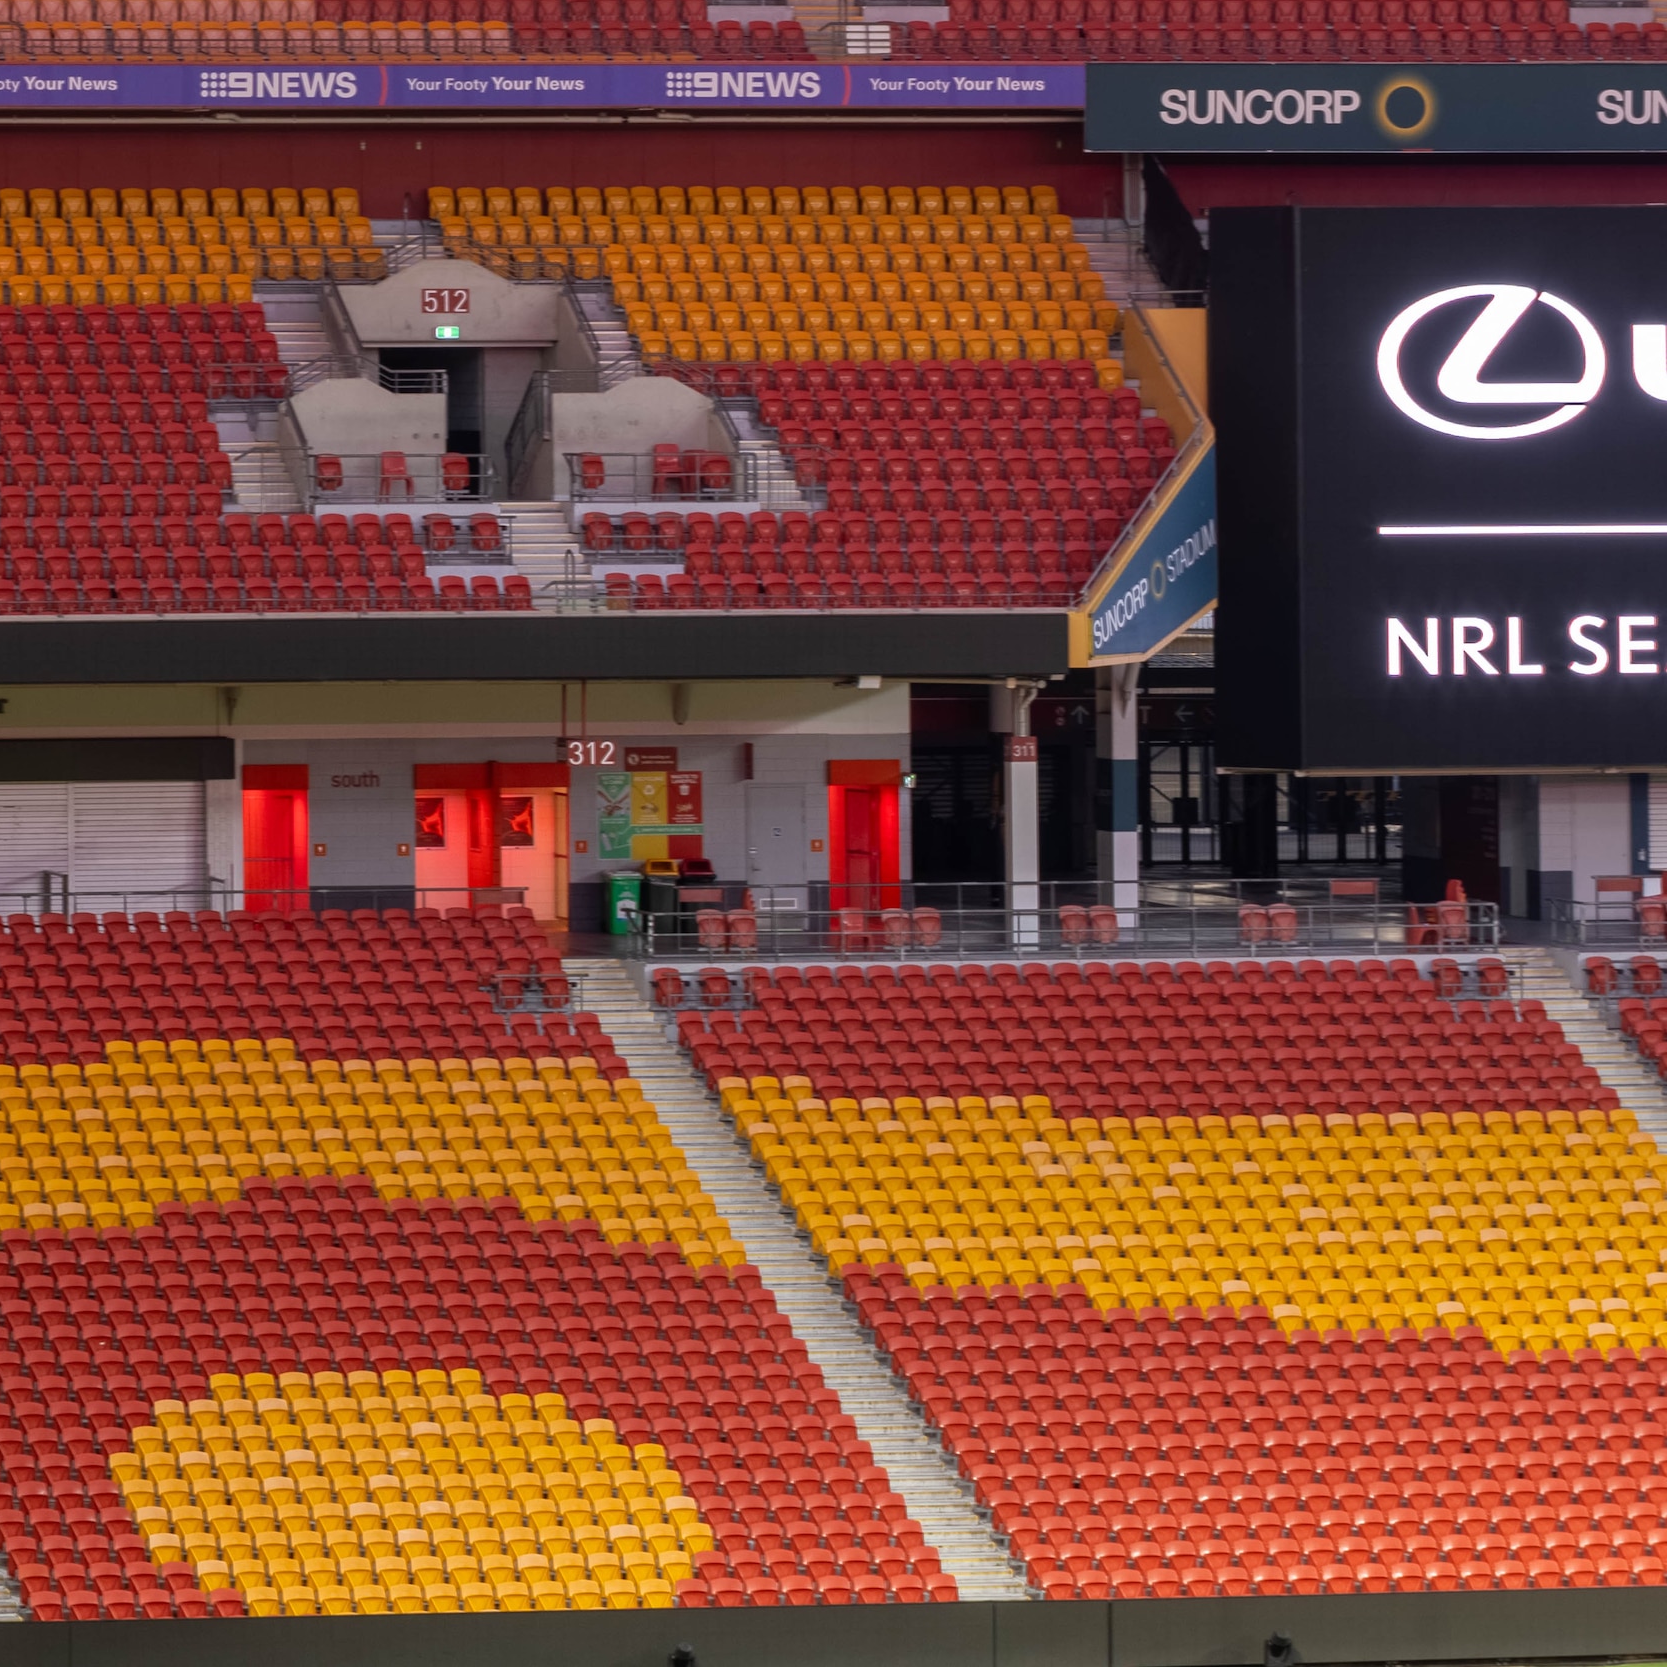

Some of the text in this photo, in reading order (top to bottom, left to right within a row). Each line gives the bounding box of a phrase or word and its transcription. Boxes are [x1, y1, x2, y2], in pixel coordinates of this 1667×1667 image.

[24, 77, 64, 90] Your
[69, 77, 117, 90] News
[407, 77, 584, 92] Your Footy Your News
[870, 77, 1044, 93] Your Footy Your News
[1159, 89, 1361, 124] SUNCORP
[423, 289, 468, 312] 512
[1093, 519, 1216, 649] SUNCORP STADIUM
[1386, 614, 1667, 676] NRL SE
[568, 741, 616, 765] 312
[1012, 745, 1035, 757] 311
[331, 770, 380, 788] south
